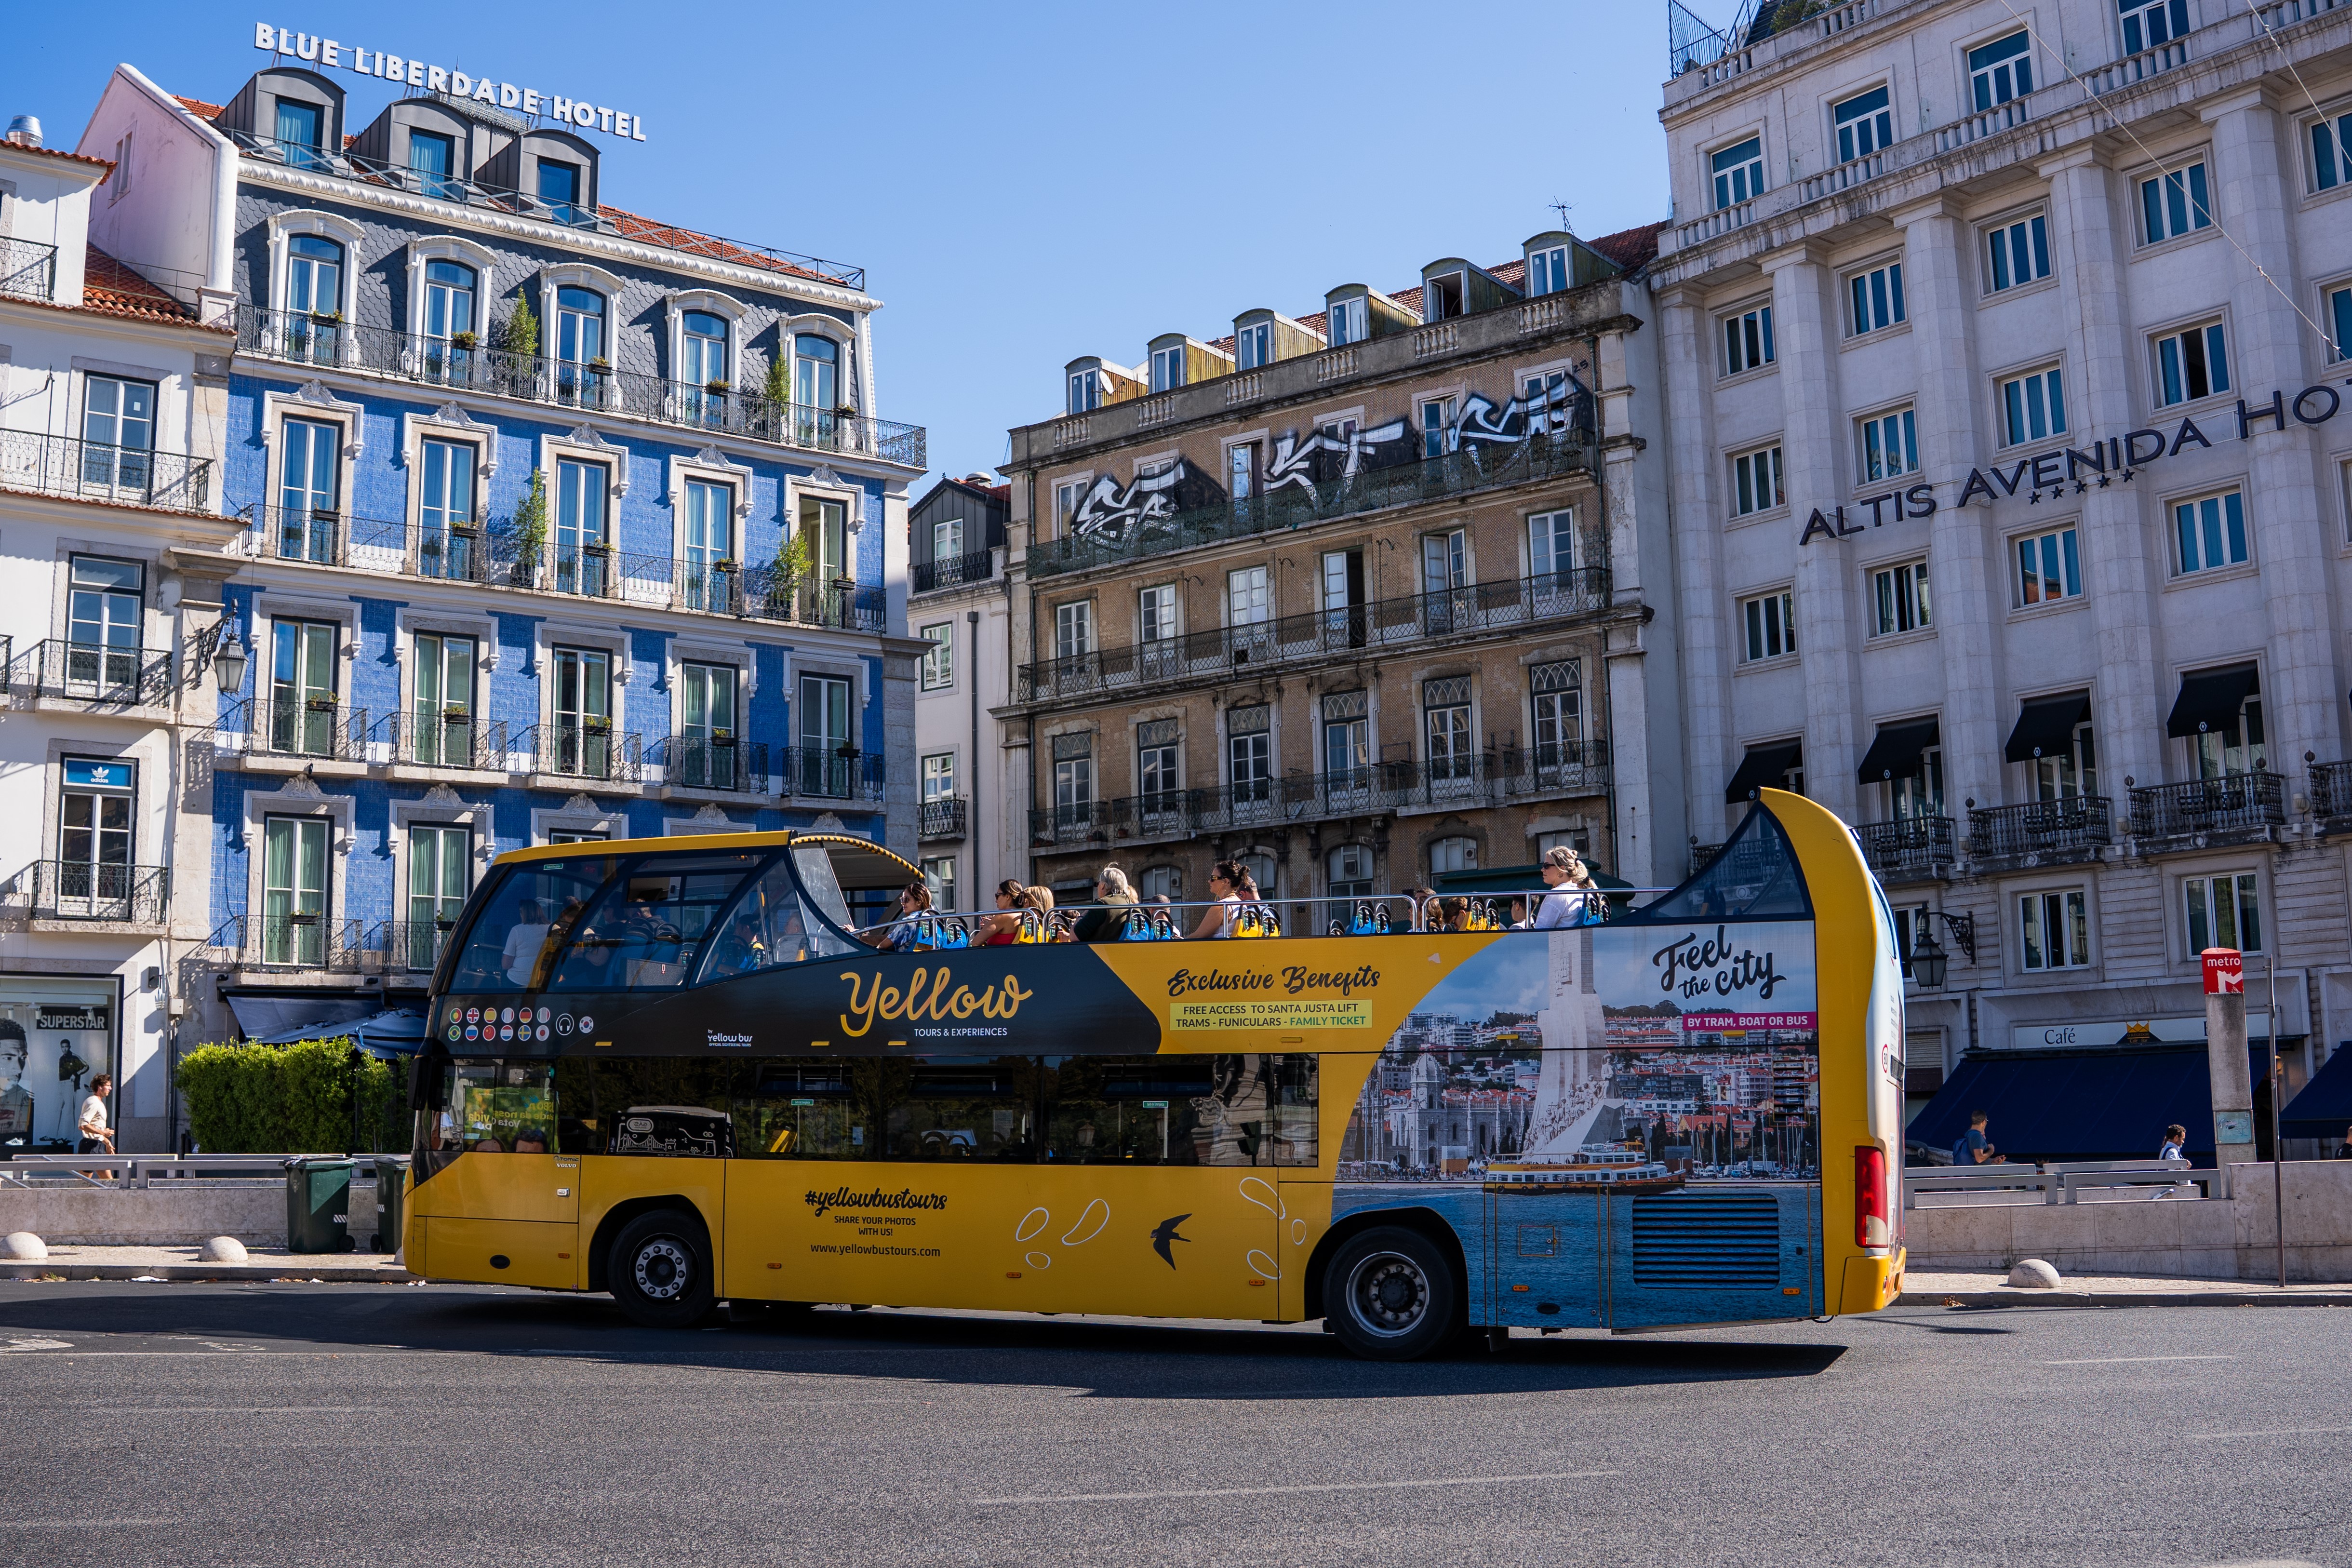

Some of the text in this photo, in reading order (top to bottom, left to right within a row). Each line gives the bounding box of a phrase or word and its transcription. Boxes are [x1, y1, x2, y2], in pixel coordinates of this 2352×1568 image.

[254, 22, 646, 142] BLUE LIBERDADE HOTEL
[1799, 483, 1937, 546] ALTIS
[1957, 417, 2212, 508] AVENIDA
[1653, 925, 1732, 992] Feel
[2207, 956, 2240, 967] metro
[1167, 965, 1380, 997] Exclusive Benefits
[1678, 950, 1787, 999] the city
[1184, 1003, 1358, 1015] FREE ACCESS TO SANTA JUSTA LIFT
[40, 1015, 105, 1029] SUPERSTAR
[1176, 1019, 1210, 1028] TRAMS
[1219, 1018, 1281, 1027] FUNICULARS
[1290, 1017, 1328, 1026] FAMILY
[1330, 1016, 1366, 1025] TICKET
[1688, 1016, 1808, 1027] BY TRAM, BOAT OR BUS
[738, 1033, 753, 1042] bus
[914, 1029, 941, 1037] TOURS
[951, 1028, 1007, 1036] EXPERIENCES
[2045, 1028, 2076, 1045] Café
[804, 1186, 948, 1217] #yellowbustours
[834, 1216, 859, 1224] SHARE
[861, 1217, 882, 1225] YOUR
[811, 1244, 940, 1257] www.yellowbustours.com
